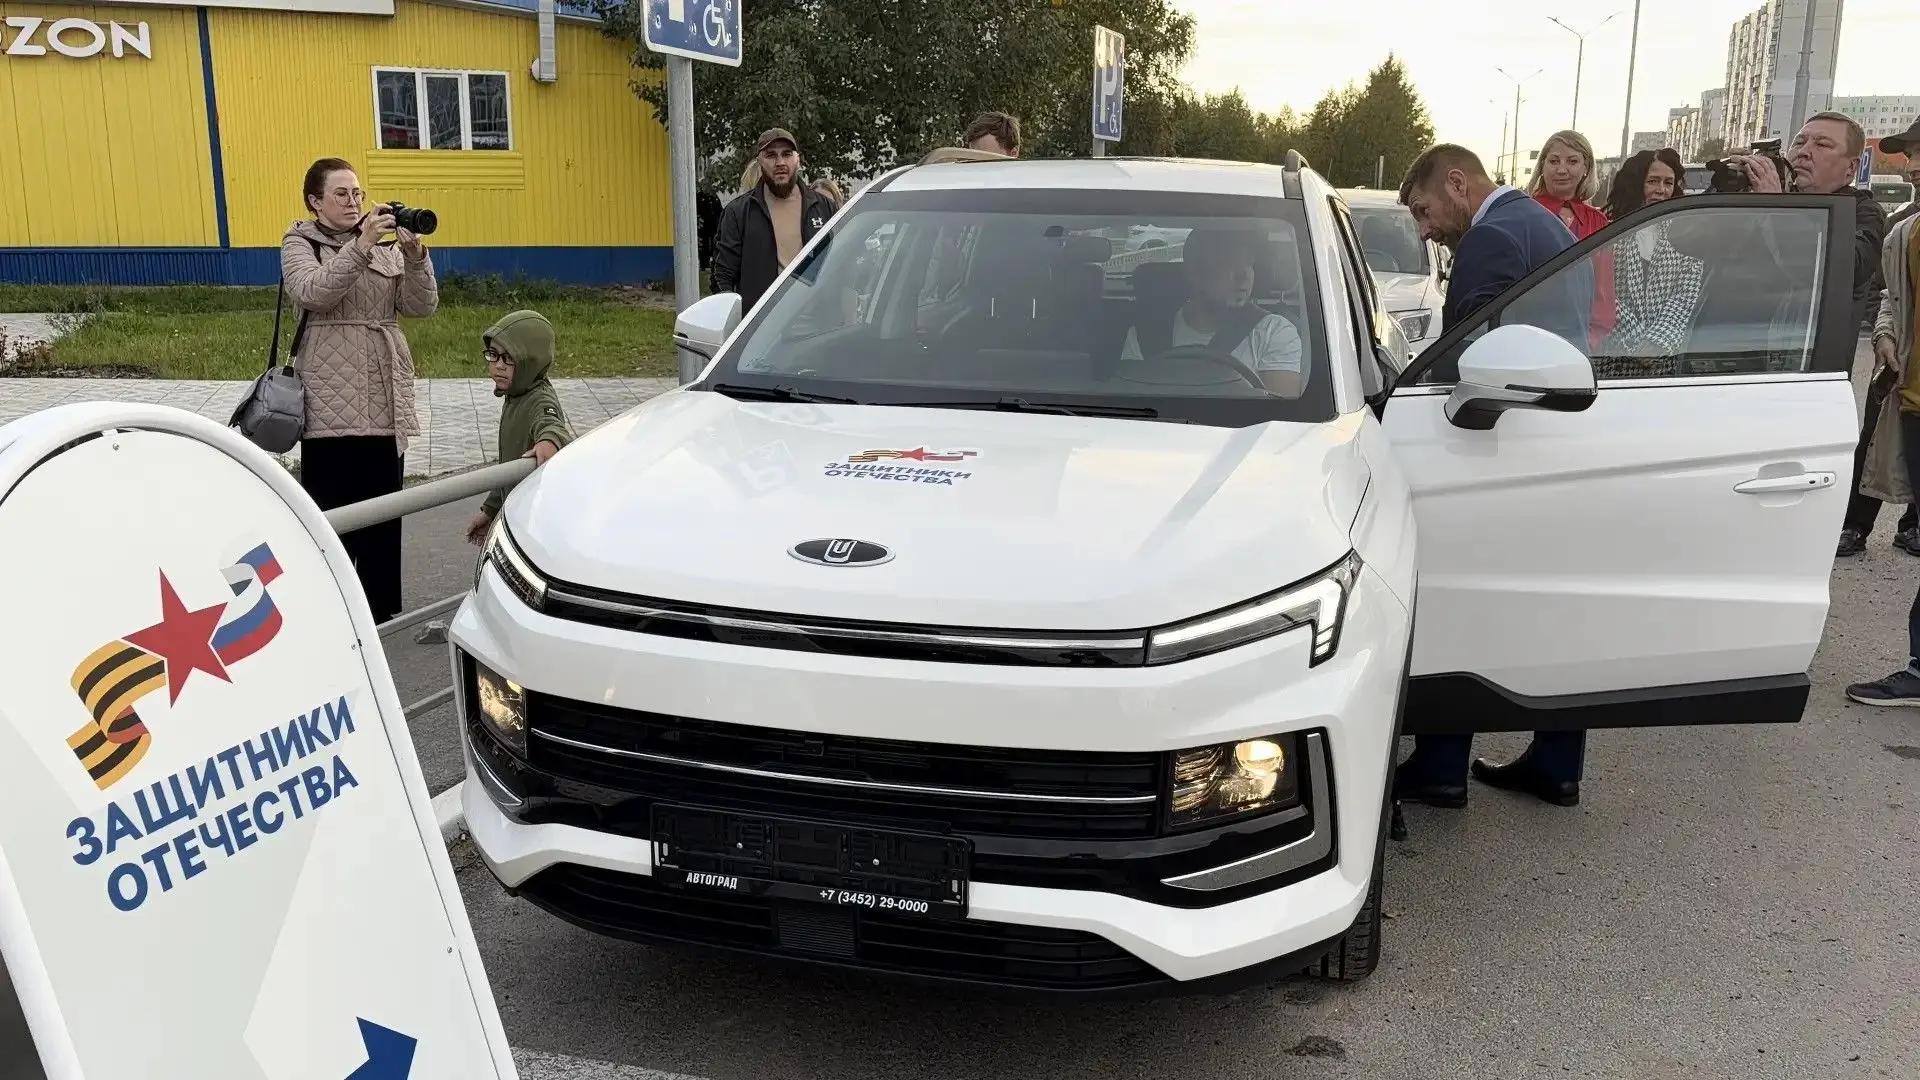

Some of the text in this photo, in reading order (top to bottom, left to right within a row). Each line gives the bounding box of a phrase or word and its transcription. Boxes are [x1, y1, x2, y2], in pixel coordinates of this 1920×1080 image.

[0, 16, 152, 59] ZON
[824, 462, 972, 480] ЗАЩИТНИКИ
[824, 470, 953, 486] ОТЕЧЕСТВА
[66, 695, 356, 866] ЗАЩИТНИКИ
[107, 754, 360, 912] ОТЕЧЕСТВА
[686, 872, 738, 890] АВТОГРАД
[819, 889, 929, 914] +7 (3452) 29-0000
